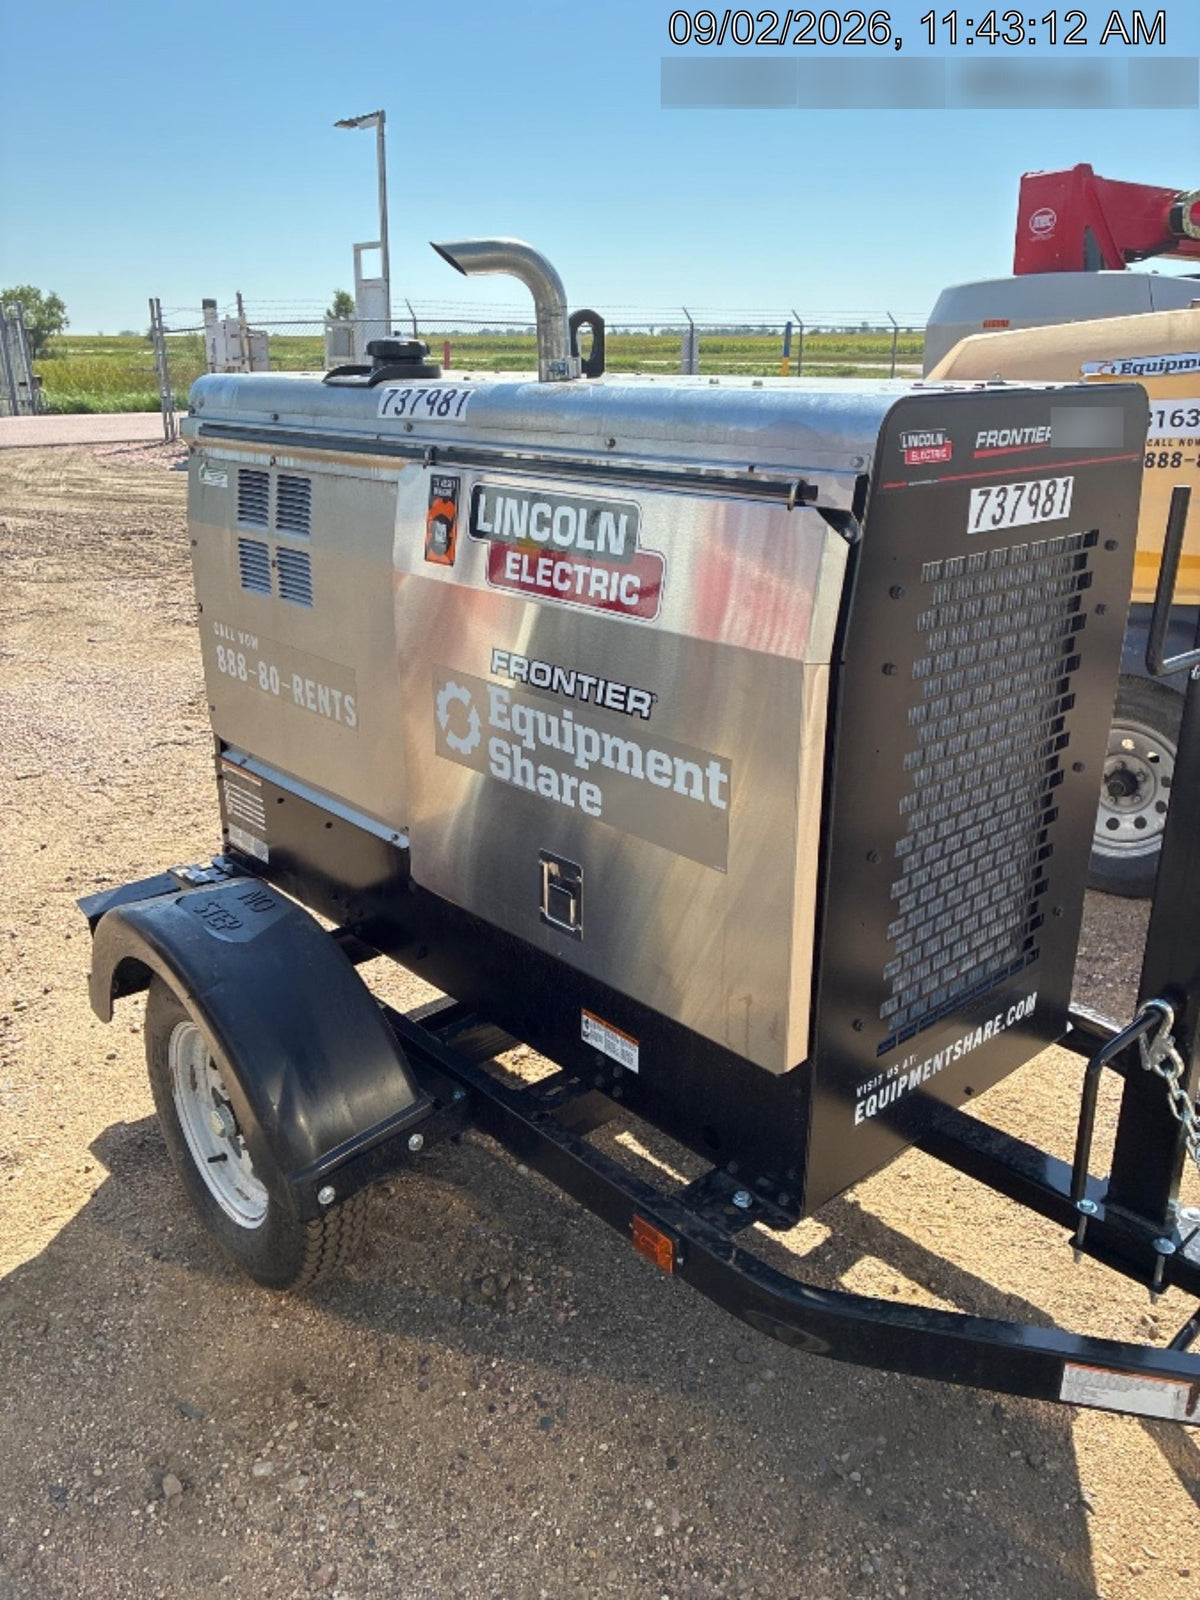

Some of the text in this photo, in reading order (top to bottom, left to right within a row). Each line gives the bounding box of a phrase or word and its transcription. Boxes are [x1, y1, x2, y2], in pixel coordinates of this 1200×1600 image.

[1120, 359, 1200, 375] Equipm
[382, 388, 470, 418] 737981
[902, 432, 944, 449] LINCOLN
[911, 448, 947, 462] ELECTRIC
[1146, 438, 1173, 447] CALL
[975, 479, 1071, 528] 737981
[476, 494, 628, 556] LINCOLN
[504, 552, 642, 605] ELECTRIC
[214, 621, 236, 641] CALL
[216, 644, 358, 727] 888-80-RENTS
[490, 648, 652, 721] FRONTIER
[486, 685, 728, 810] Equipment
[488, 736, 602, 818] Share
[193, 901, 244, 931] STEP
[237, 890, 276, 912] NO
[854, 991, 1038, 1126] EQUIPMENTSHARE.COM
[856, 1073, 884, 1098] VISIT
[886, 1064, 900, 1079] US
